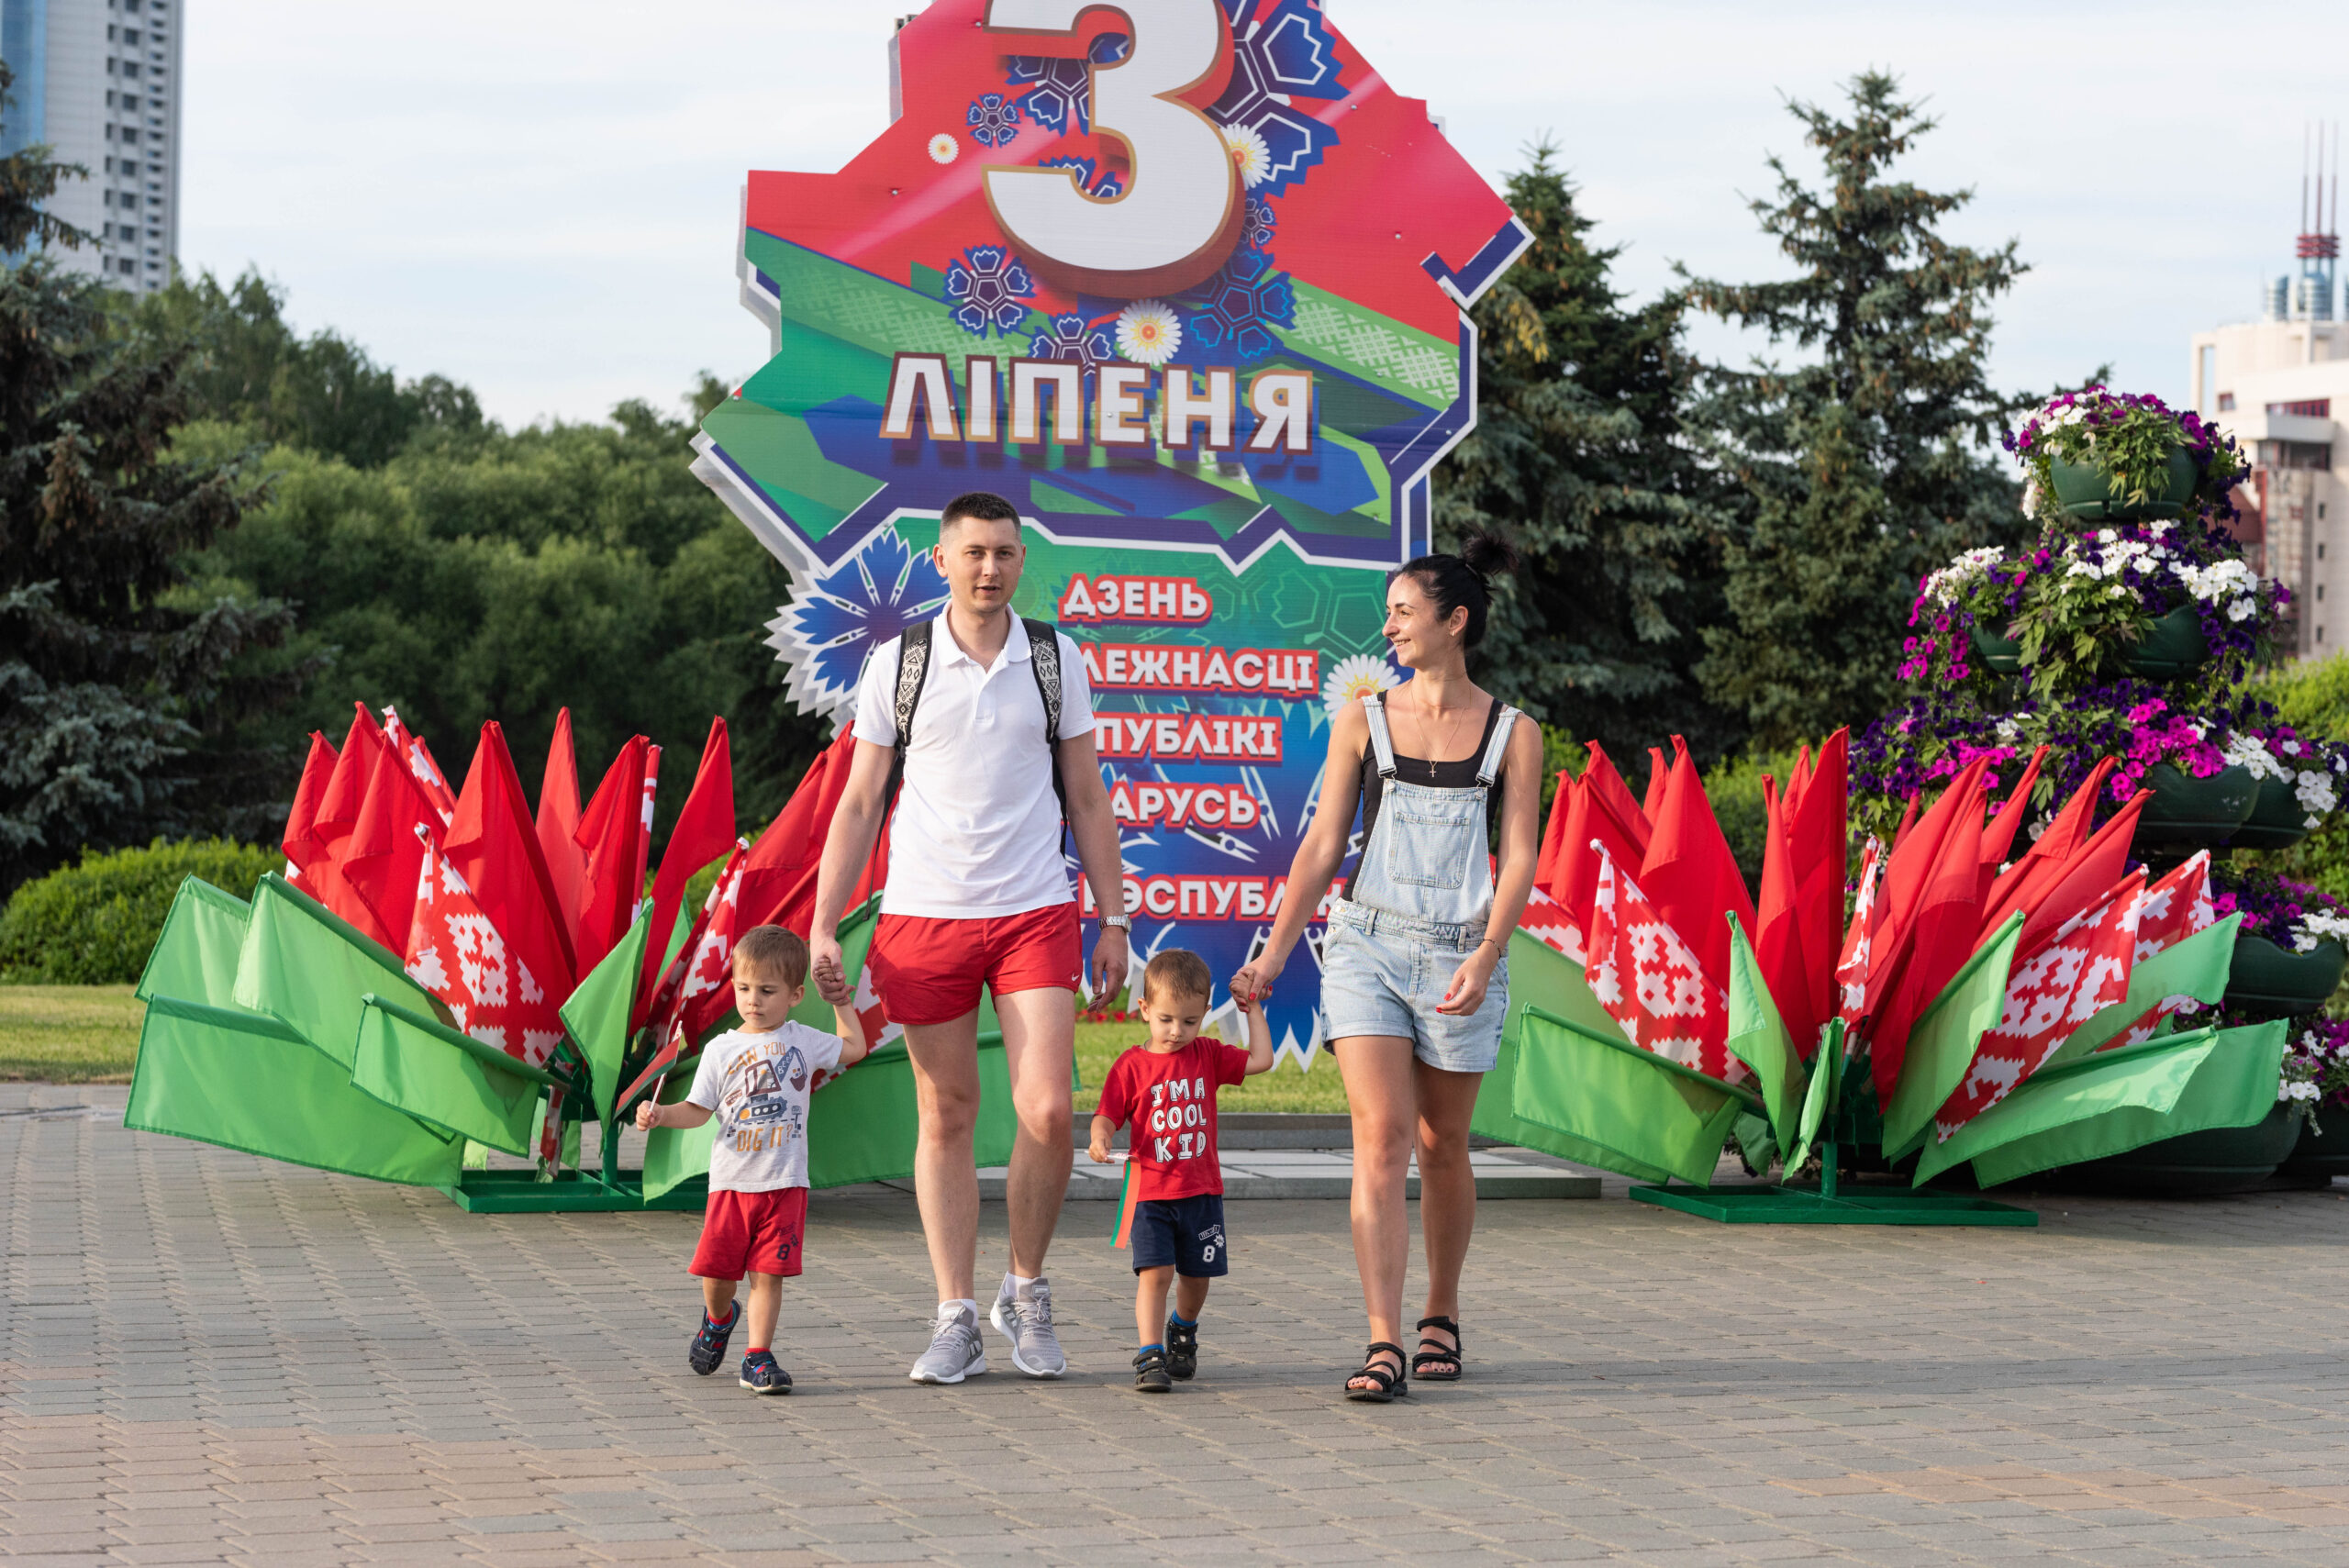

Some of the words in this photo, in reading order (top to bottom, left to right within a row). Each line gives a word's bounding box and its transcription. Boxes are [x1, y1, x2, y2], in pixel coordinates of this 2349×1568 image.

[981, 0, 1241, 277] 3
[879, 351, 1312, 455] ЛІПЕНЯ
[1063, 579, 1208, 619] ДЗЕНЬ
[1083, 648, 1313, 691] ЛЕЖНАСЦІ
[1096, 717, 1276, 758] ПУБЛІКІ
[1111, 786, 1255, 825] АРУСЬ
[763, 1041, 785, 1056] YOU
[1151, 1079, 1190, 1107] I'M
[1194, 1077, 1206, 1099] A
[1151, 1104, 1207, 1133] COOL
[737, 1128, 764, 1151] DIG
[1154, 1130, 1207, 1163] KID
[776, 1243, 790, 1261] 8
[1203, 1245, 1215, 1262] 8
